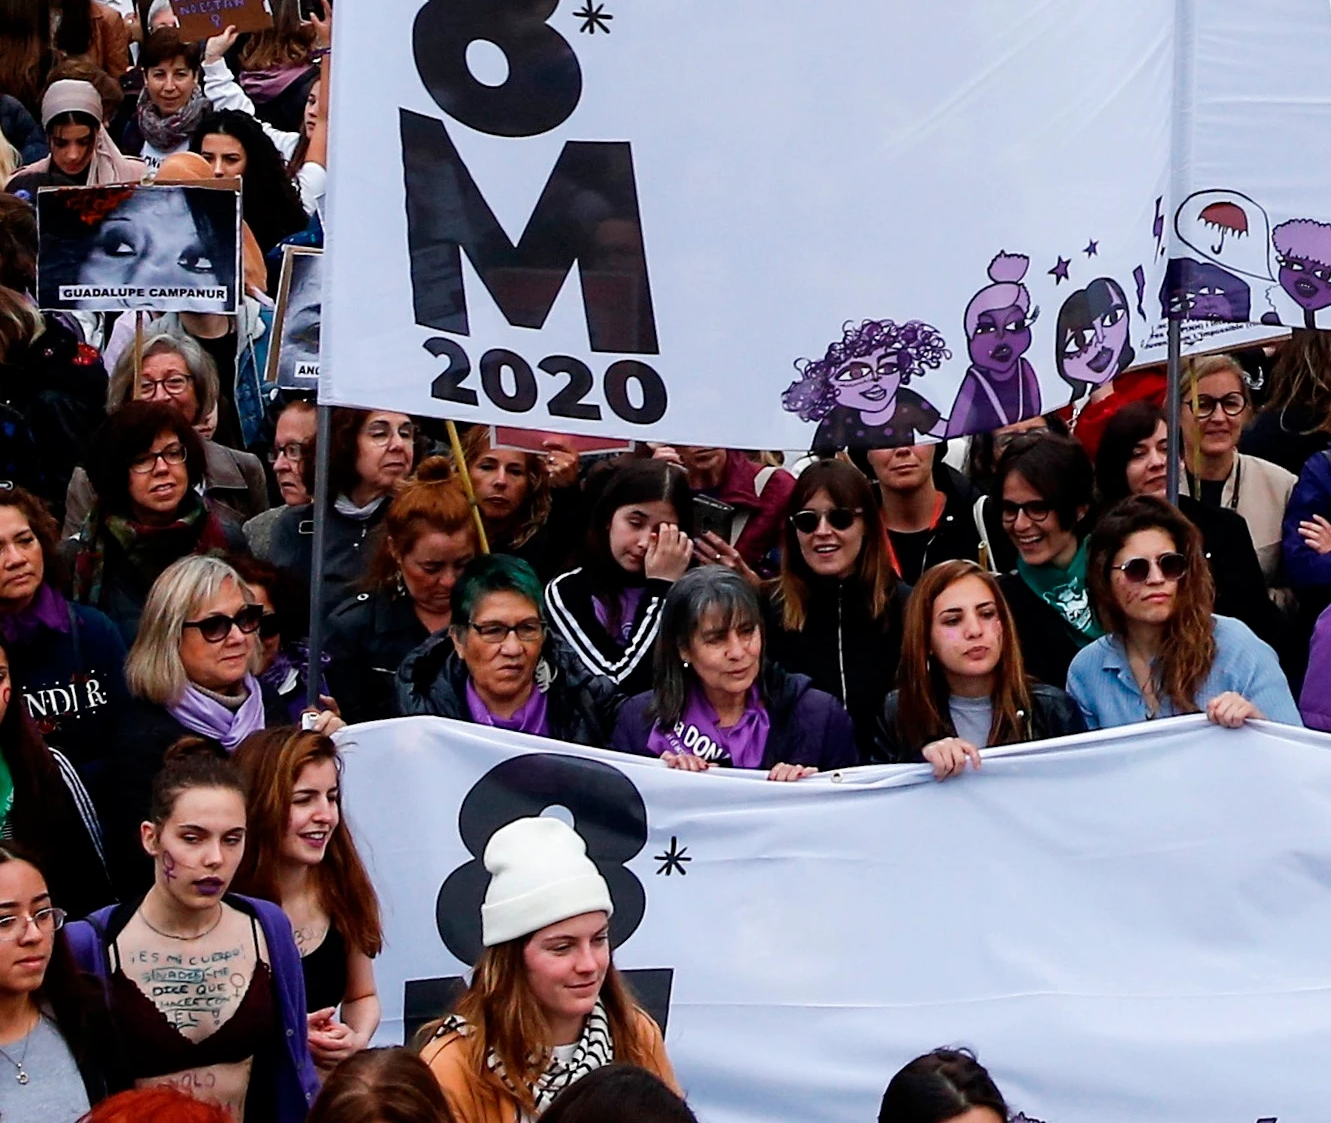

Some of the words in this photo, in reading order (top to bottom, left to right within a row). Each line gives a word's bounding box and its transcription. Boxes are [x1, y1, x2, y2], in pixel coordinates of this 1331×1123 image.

[399, 106, 661, 356] M
[63, 287, 145, 298] GUADALUPE
[149, 287, 226, 300] CAMPANUR
[423, 336, 668, 424] 2020
[683, 724, 731, 761] DON
[196, 983, 228, 996] QUE
